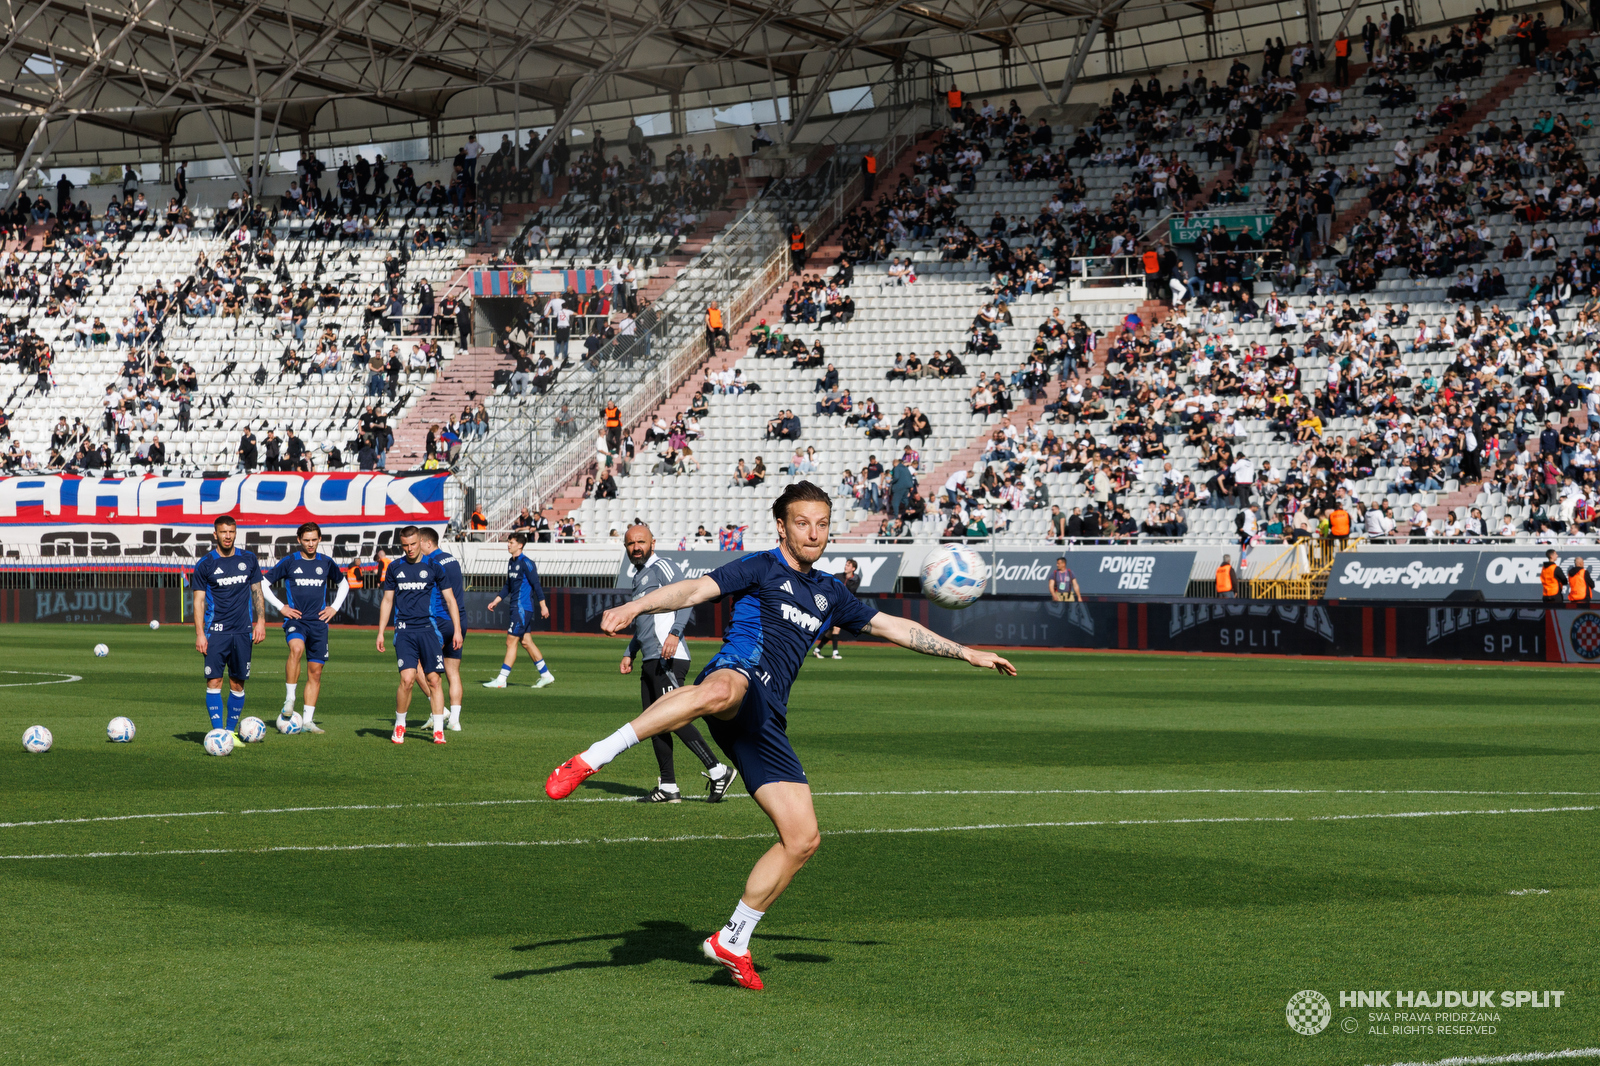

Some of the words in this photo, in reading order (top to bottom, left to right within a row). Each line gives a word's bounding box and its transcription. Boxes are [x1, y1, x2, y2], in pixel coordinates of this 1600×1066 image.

[1174, 219, 1211, 230] IZLAZ
[1180, 231, 1201, 240] EXI
[77, 474, 436, 517] HAJDUK
[1099, 556, 1156, 573] POWER
[1117, 573, 1152, 590] ADE
[1339, 560, 1464, 589] SuperSport
[36, 590, 132, 620] HAJDUK
[66, 614, 102, 622] SPLIT
[468, 610, 505, 624] SPLIT
[1574, 614, 1600, 629] HAJDU
[214, 623, 224, 632] 29
[398, 621, 406, 630] 34
[995, 623, 1048, 640] SPLIT
[1220, 628, 1281, 647] SPLIT
